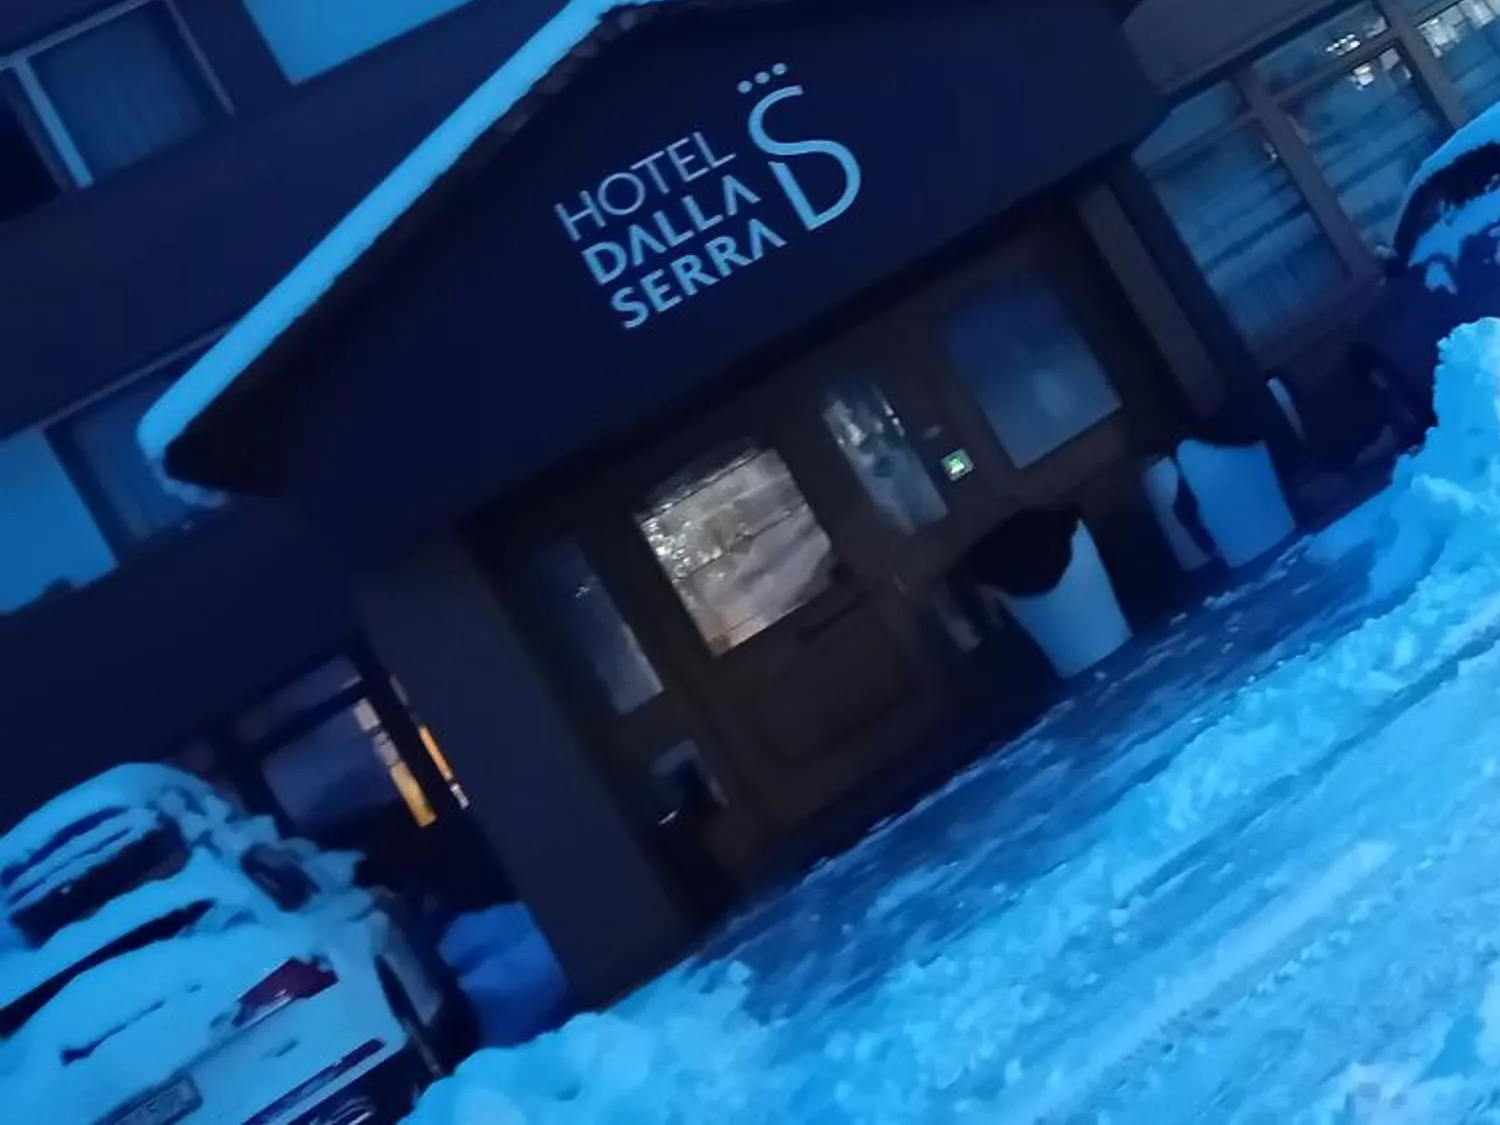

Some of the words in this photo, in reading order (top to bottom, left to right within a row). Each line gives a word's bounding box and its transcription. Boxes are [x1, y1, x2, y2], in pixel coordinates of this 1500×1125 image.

[554, 132, 736, 241] HOTEL
[581, 175, 761, 286] DALLA
[611, 219, 788, 329] SERRA
